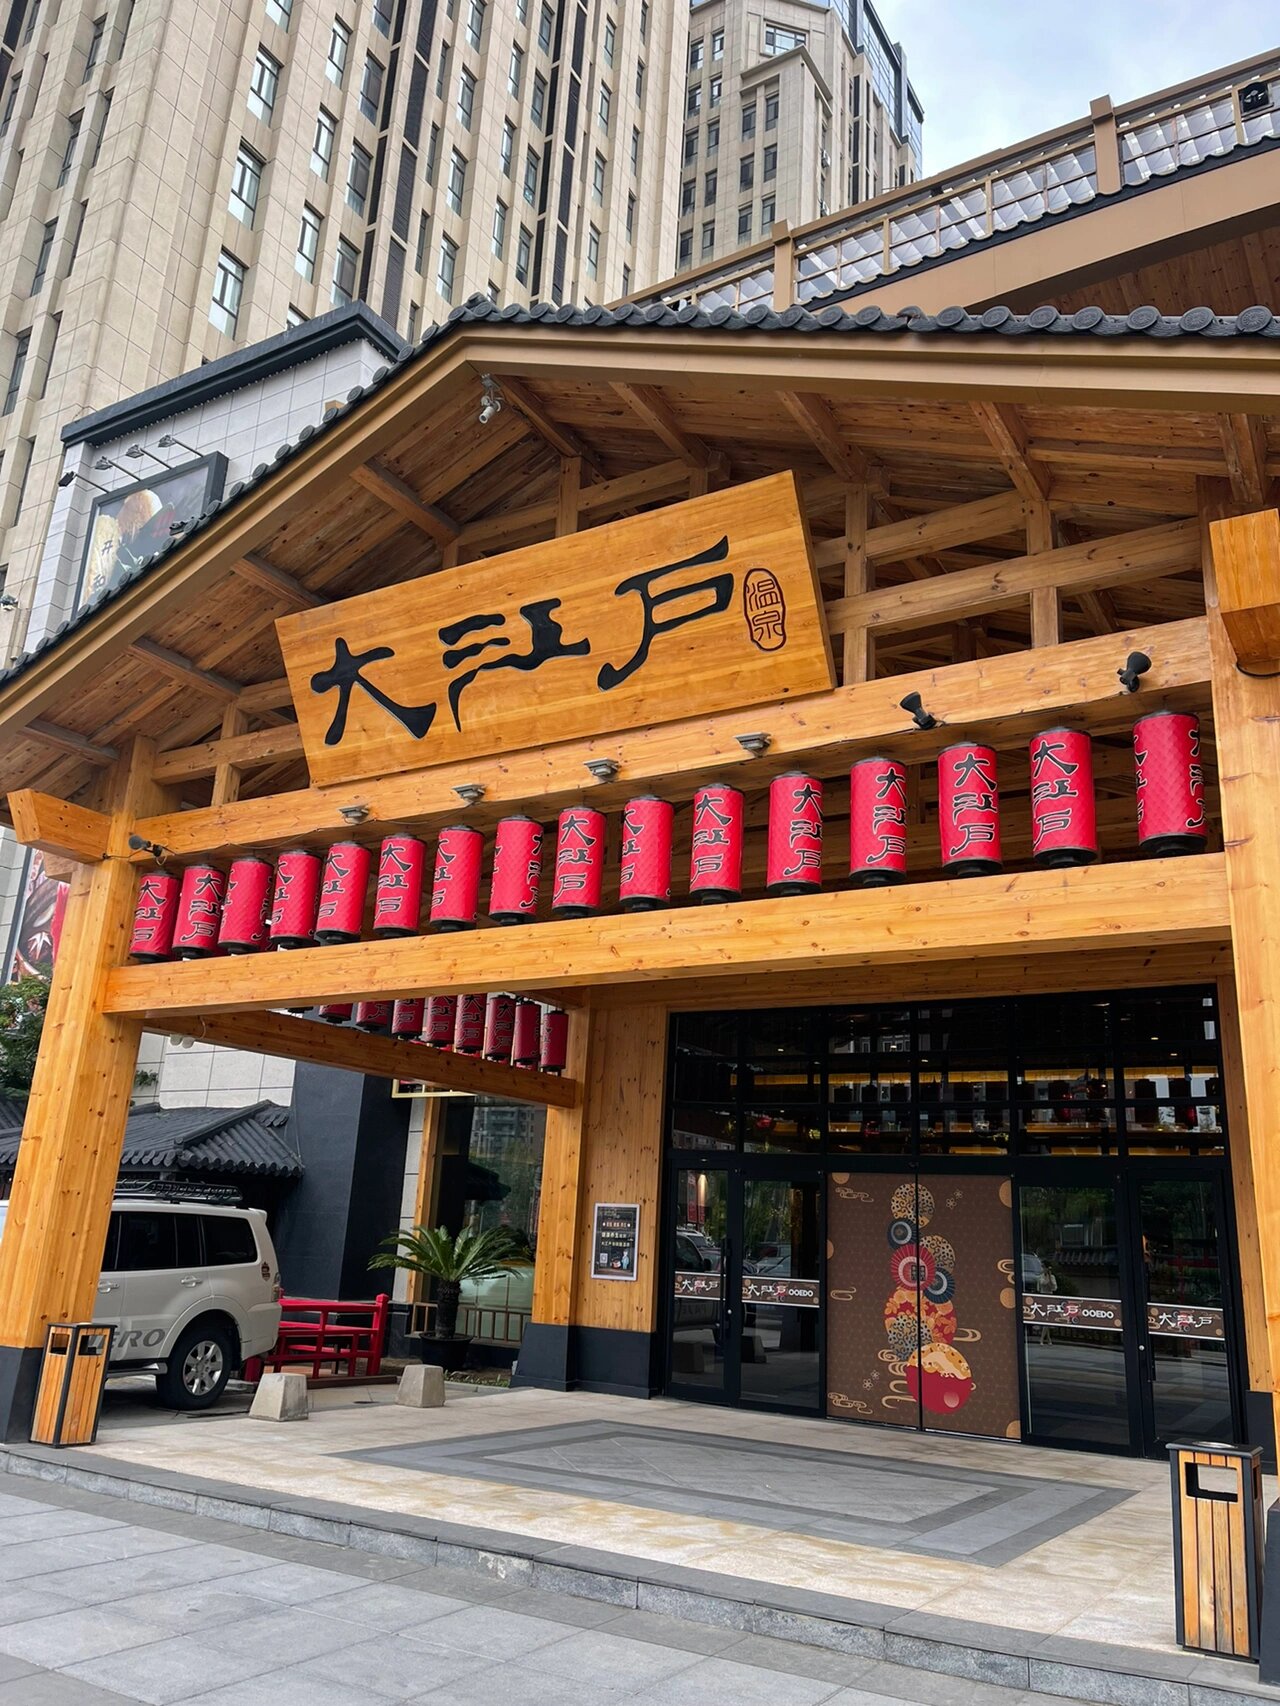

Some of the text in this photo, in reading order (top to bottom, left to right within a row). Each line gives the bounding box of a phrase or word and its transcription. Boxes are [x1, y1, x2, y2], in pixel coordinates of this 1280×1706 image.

[746, 576, 784, 643] 温泉
[788, 1288, 814, 1297] OOEDO
[1082, 1309, 1114, 1319] OOEDO
